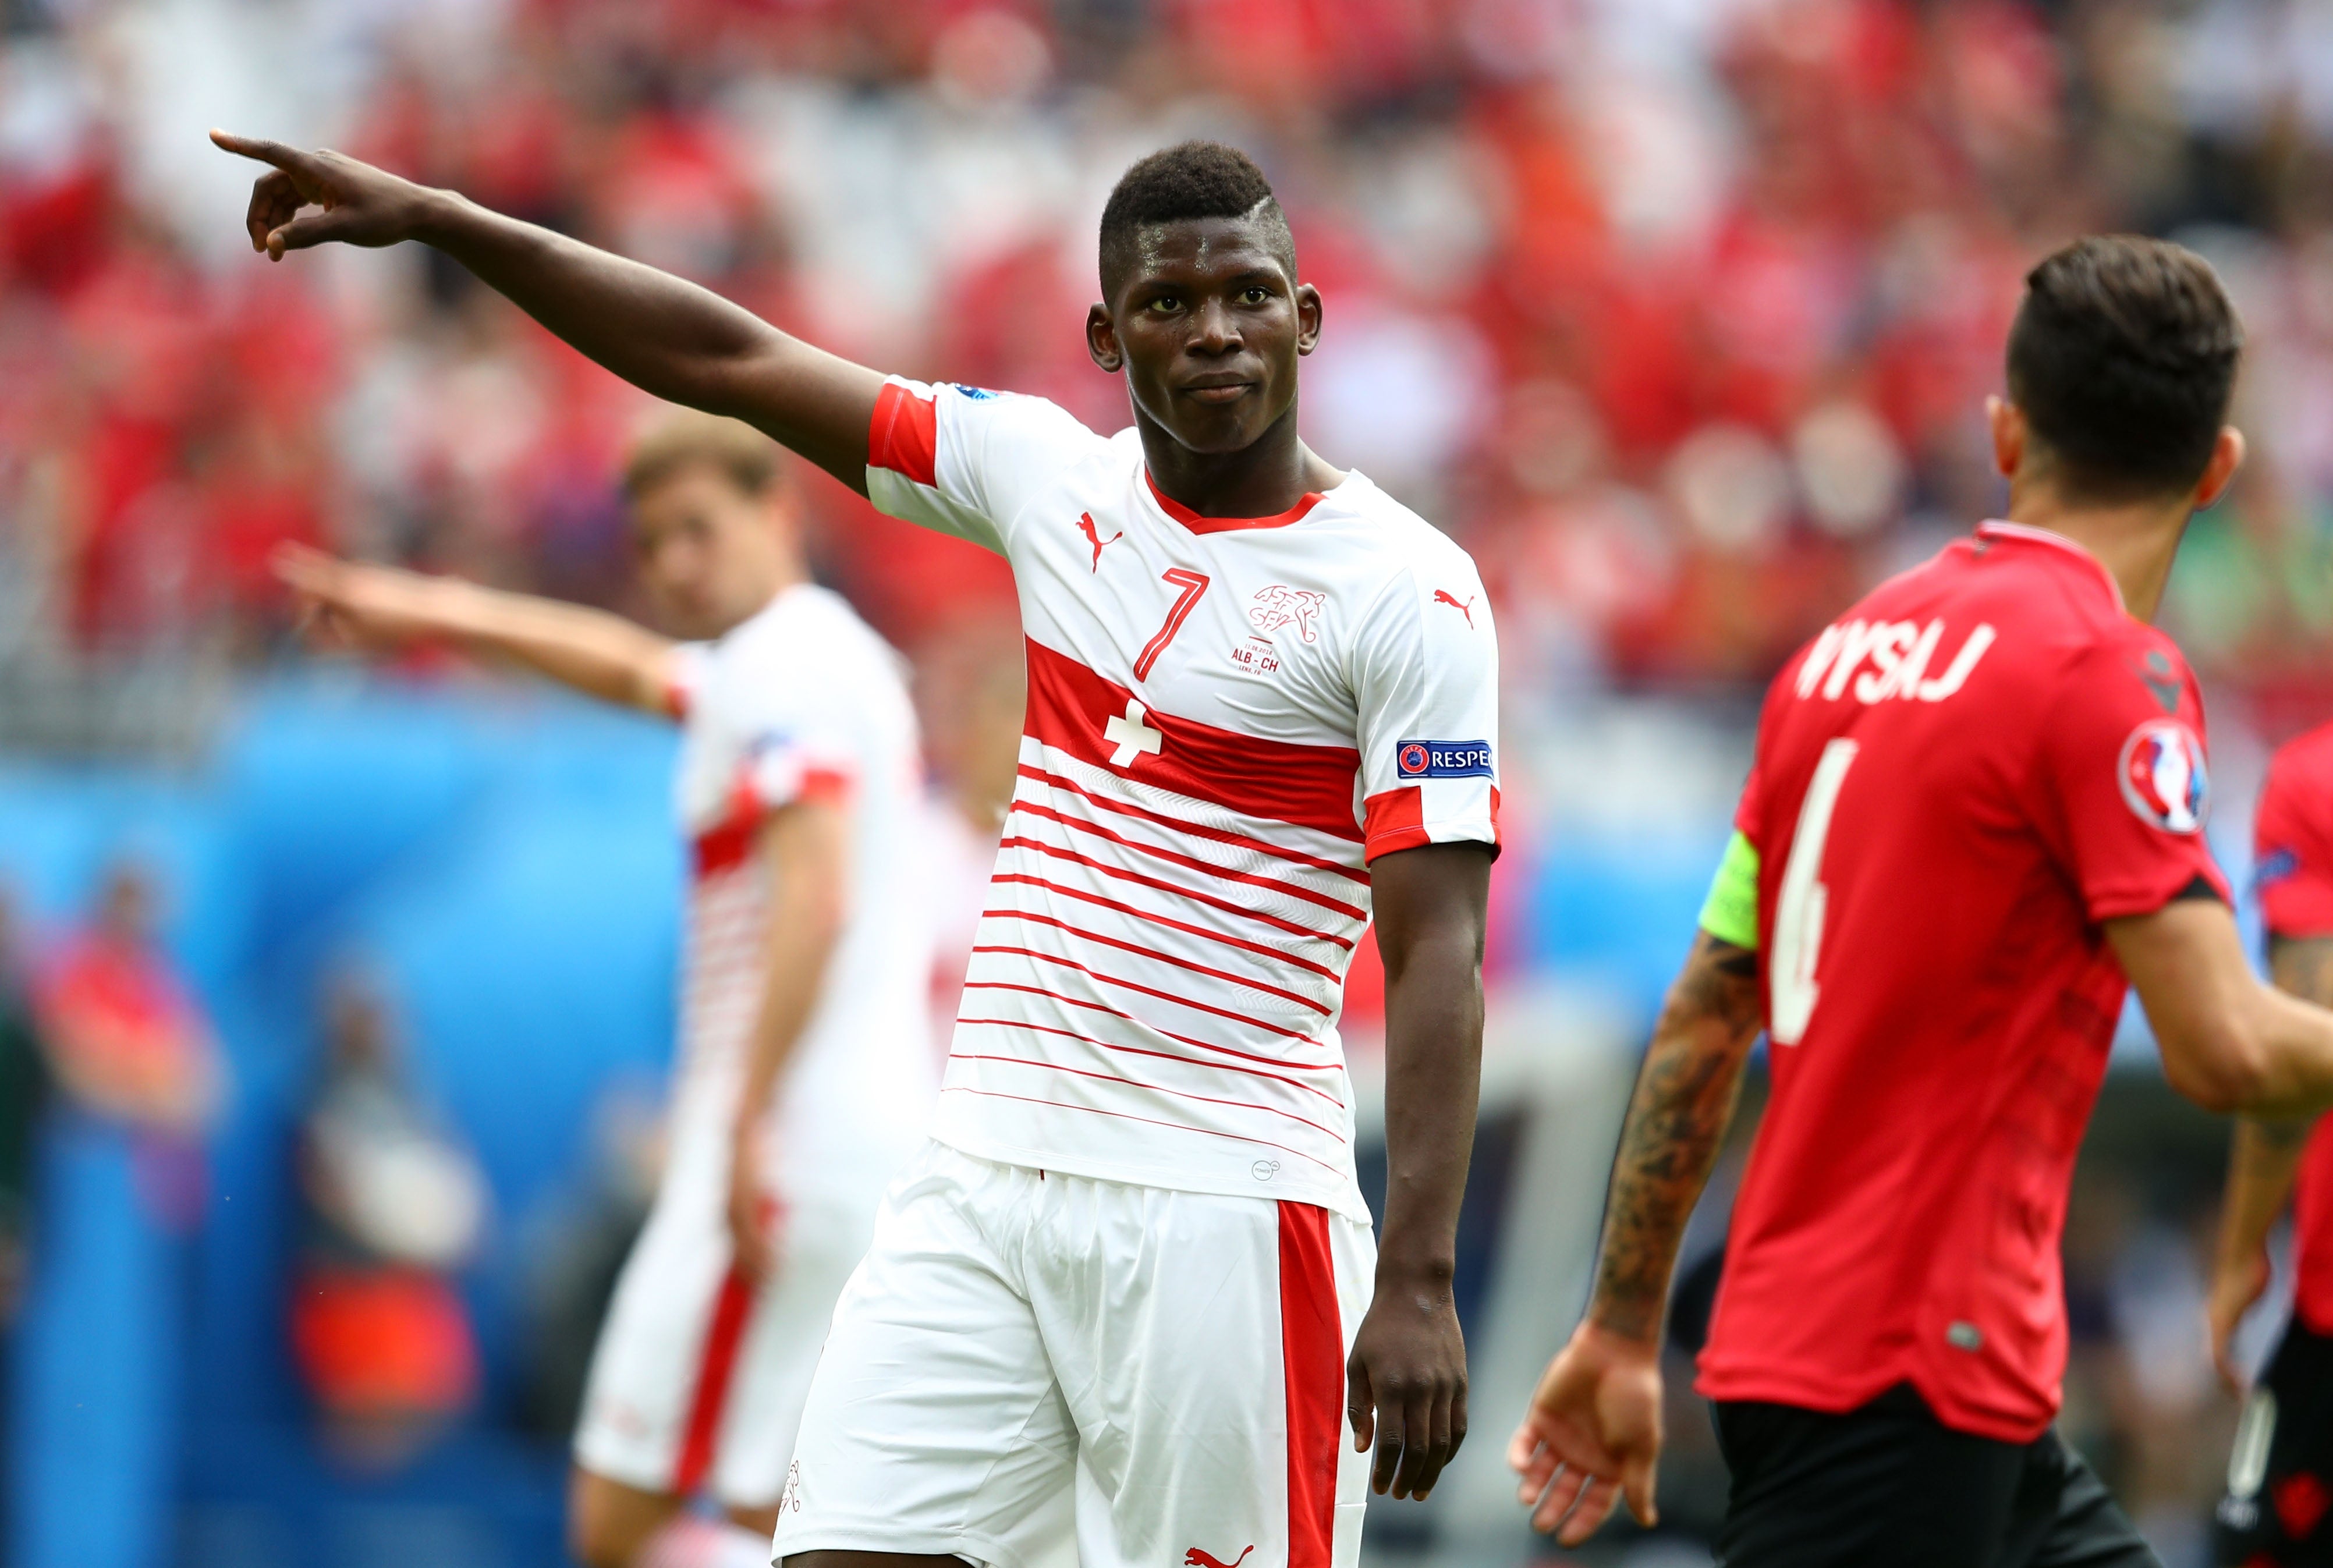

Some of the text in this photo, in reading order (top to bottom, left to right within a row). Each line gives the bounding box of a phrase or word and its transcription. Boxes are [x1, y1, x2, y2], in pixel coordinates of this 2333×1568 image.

[1161, 567, 1210, 683] 7
[1231, 648, 1252, 664] ALB
[1261, 657, 1279, 672] CH
